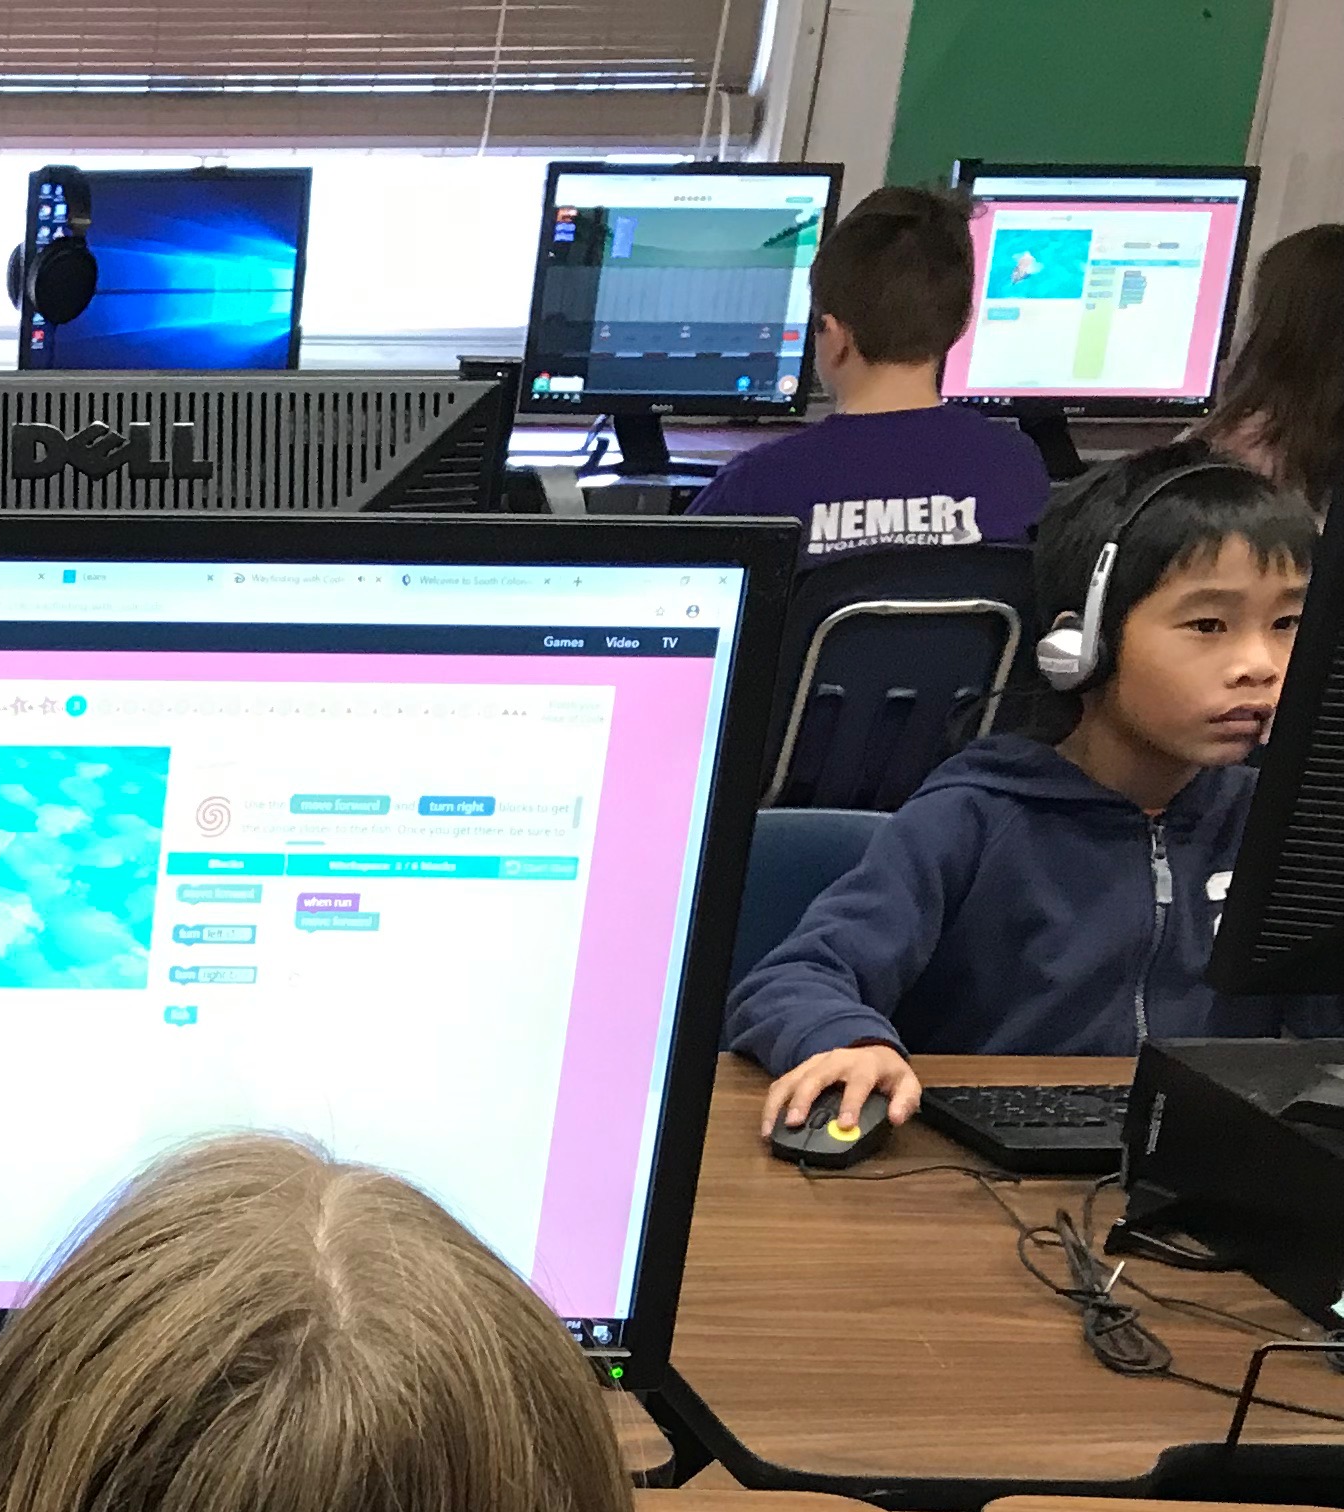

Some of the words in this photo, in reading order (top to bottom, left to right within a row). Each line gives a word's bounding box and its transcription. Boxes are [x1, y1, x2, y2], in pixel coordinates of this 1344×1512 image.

[12, 420, 213, 480] DELL
[825, 534, 939, 552] VOLKSWAGEN
[419, 575, 460, 587] Welcome
[462, 577, 472, 587] to
[474, 577, 499, 587] South
[543, 636, 584, 648] Games
[606, 636, 640, 649] Video
[662, 637, 679, 648] TV
[394, 801, 416, 811] and
[429, 802, 455, 812] turn
[456, 800, 485, 815] right
[499, 801, 534, 812] blocks
[552, 804, 570, 816] get
[397, 825, 426, 837] Once
[452, 828, 471, 840] get
[304, 896, 331, 908] when
[334, 898, 352, 908] run
